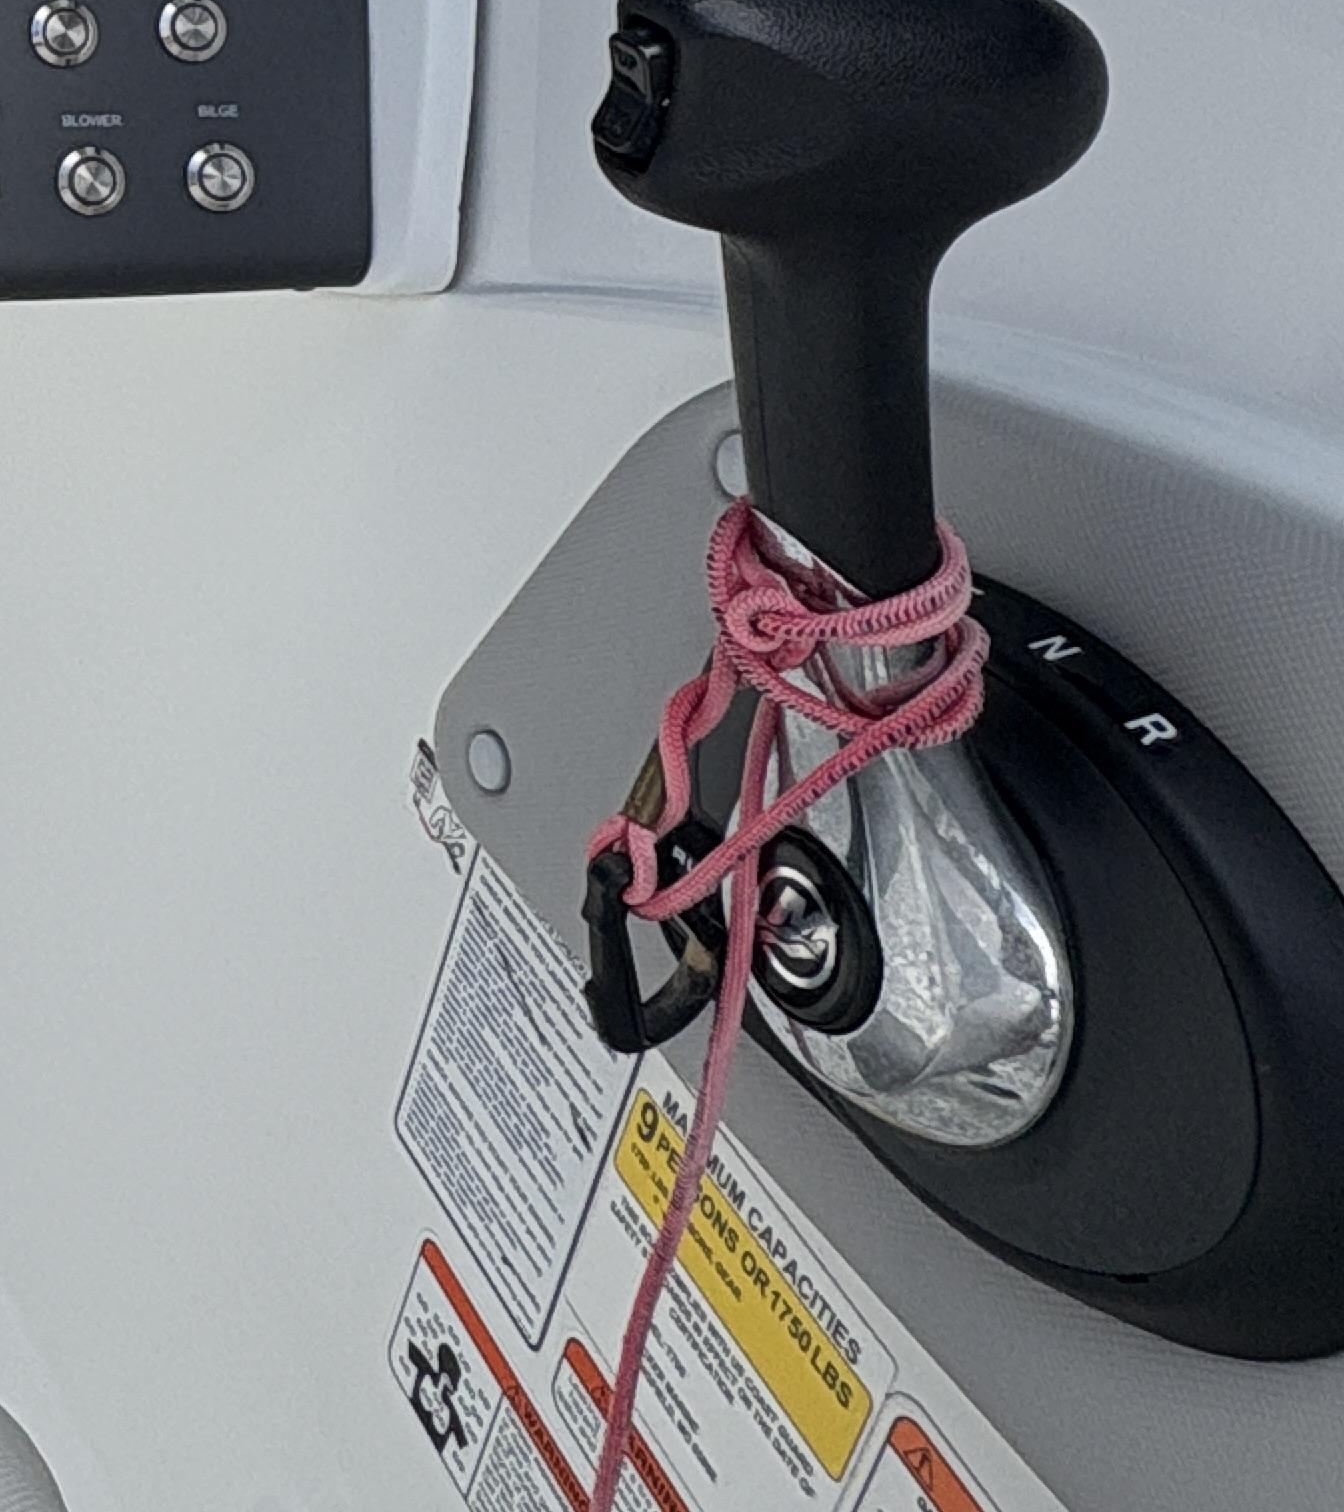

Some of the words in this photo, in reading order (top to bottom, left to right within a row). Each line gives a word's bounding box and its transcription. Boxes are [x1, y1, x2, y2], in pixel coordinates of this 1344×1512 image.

[62, 114, 123, 128] BLOWER
[197, 104, 238, 118] BILGE
[1027, 635, 1082, 662] N
[1123, 712, 1178, 746] R
[661, 1088, 747, 1213] MAMUM
[745, 1202, 863, 1368] CAPACITIES
[634, 1095, 661, 1150] 9
[655, 1130, 740, 1257] PEONS
[738, 1245, 772, 1301] OR
[766, 1283, 814, 1357] 1750
[809, 1341, 854, 1413] LBS
